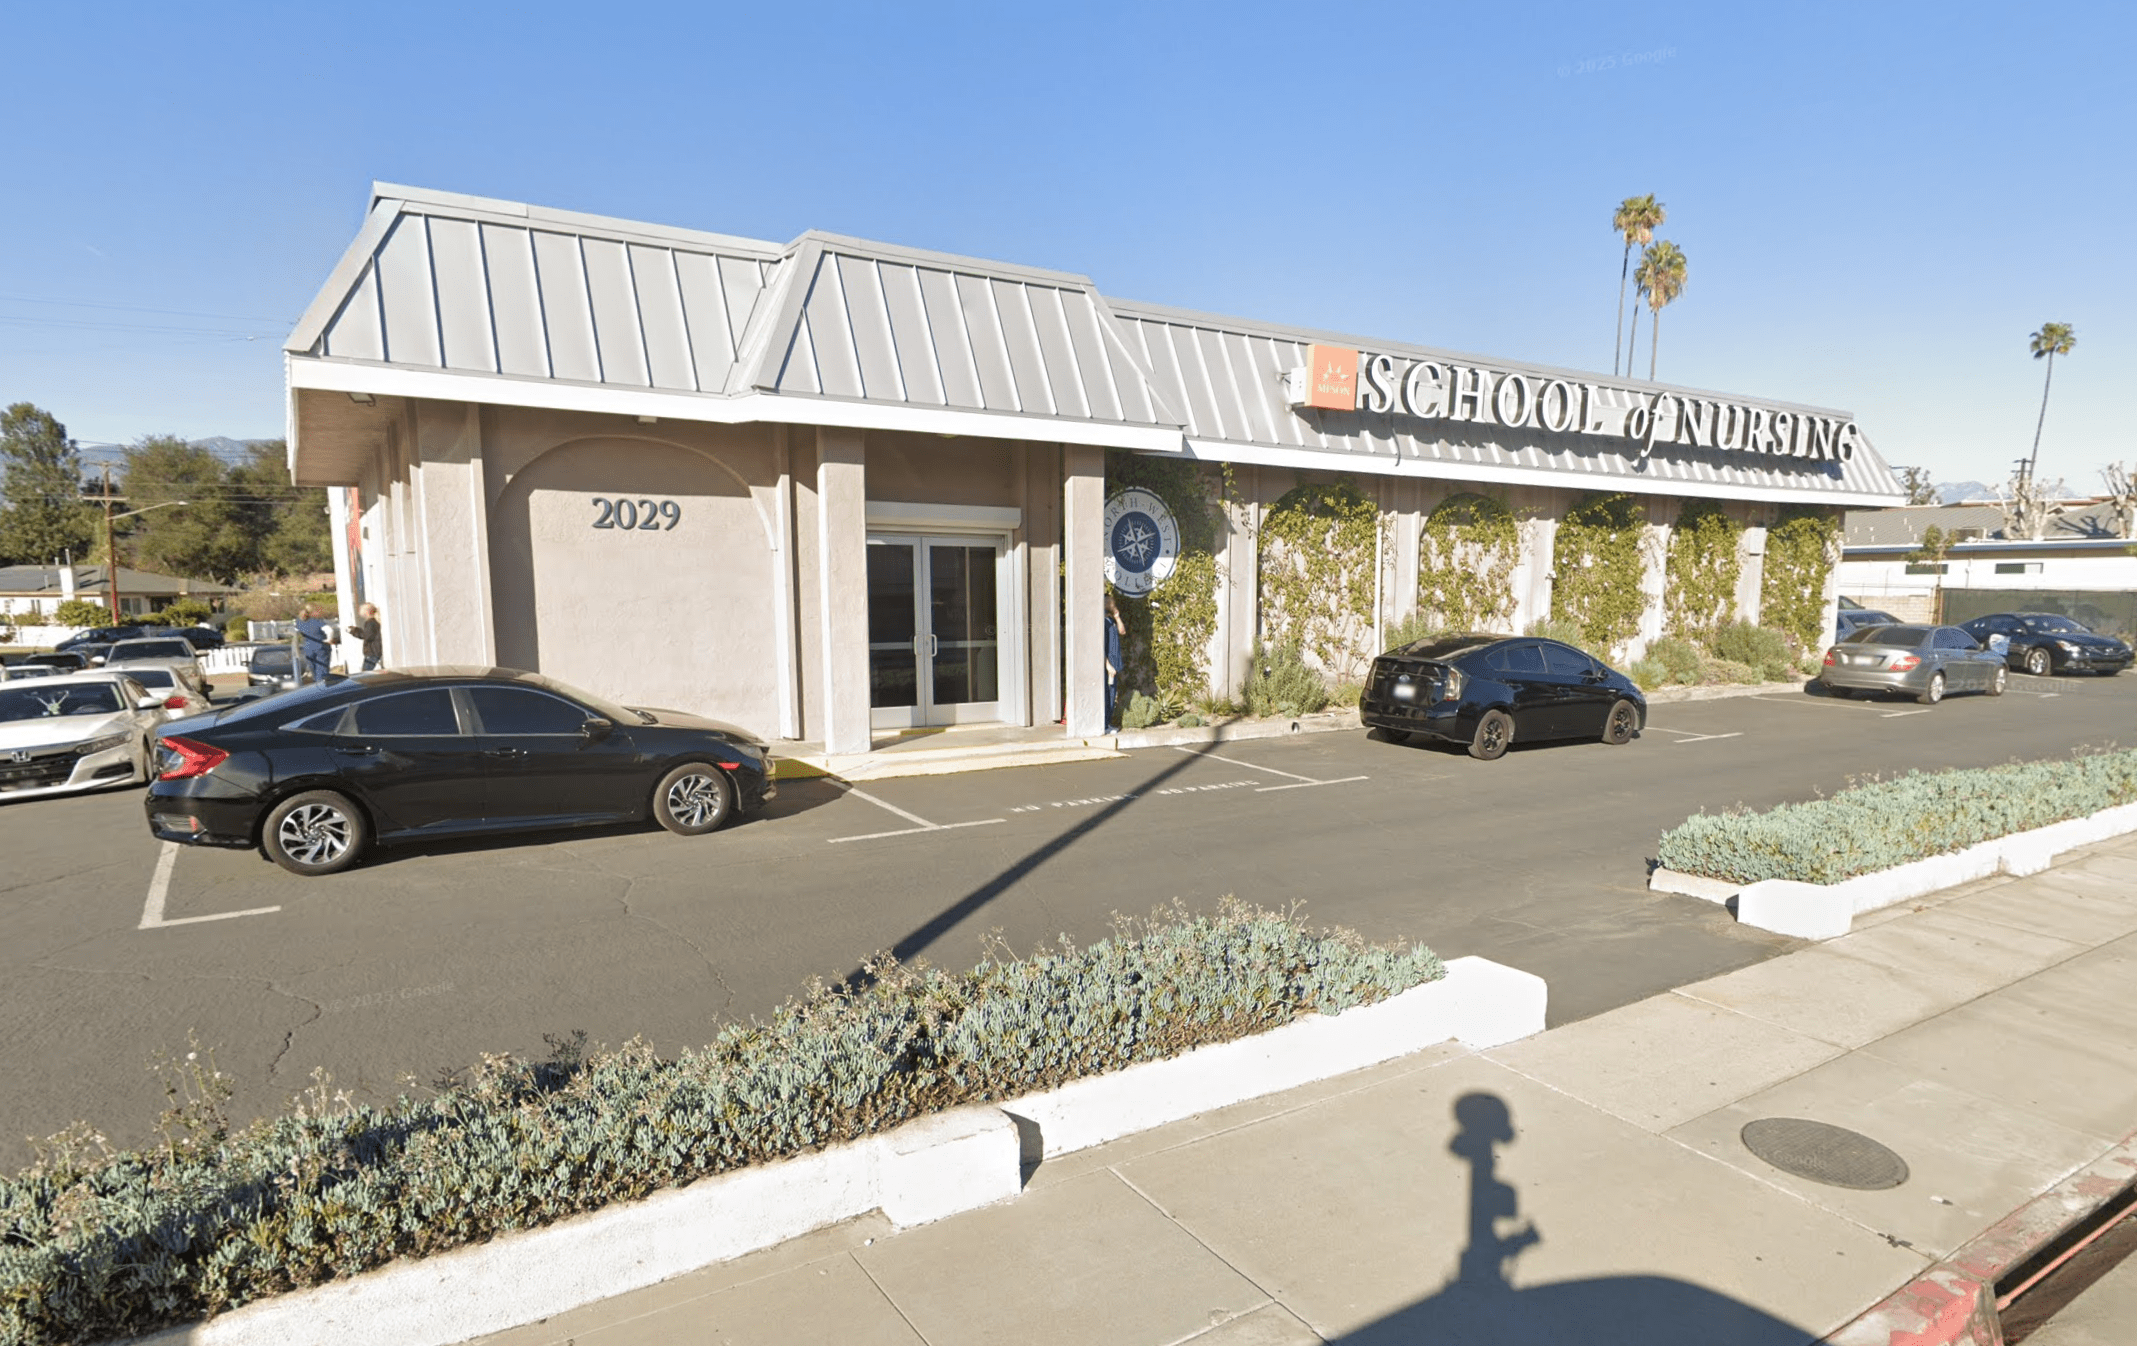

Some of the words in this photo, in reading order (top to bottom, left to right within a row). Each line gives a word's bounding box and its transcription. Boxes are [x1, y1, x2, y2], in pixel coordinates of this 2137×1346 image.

[1365, 354, 1605, 433] SCHOOL
[1624, 391, 1671, 458] of
[1673, 397, 1858, 463] NURSING
[592, 497, 681, 531] 2029
